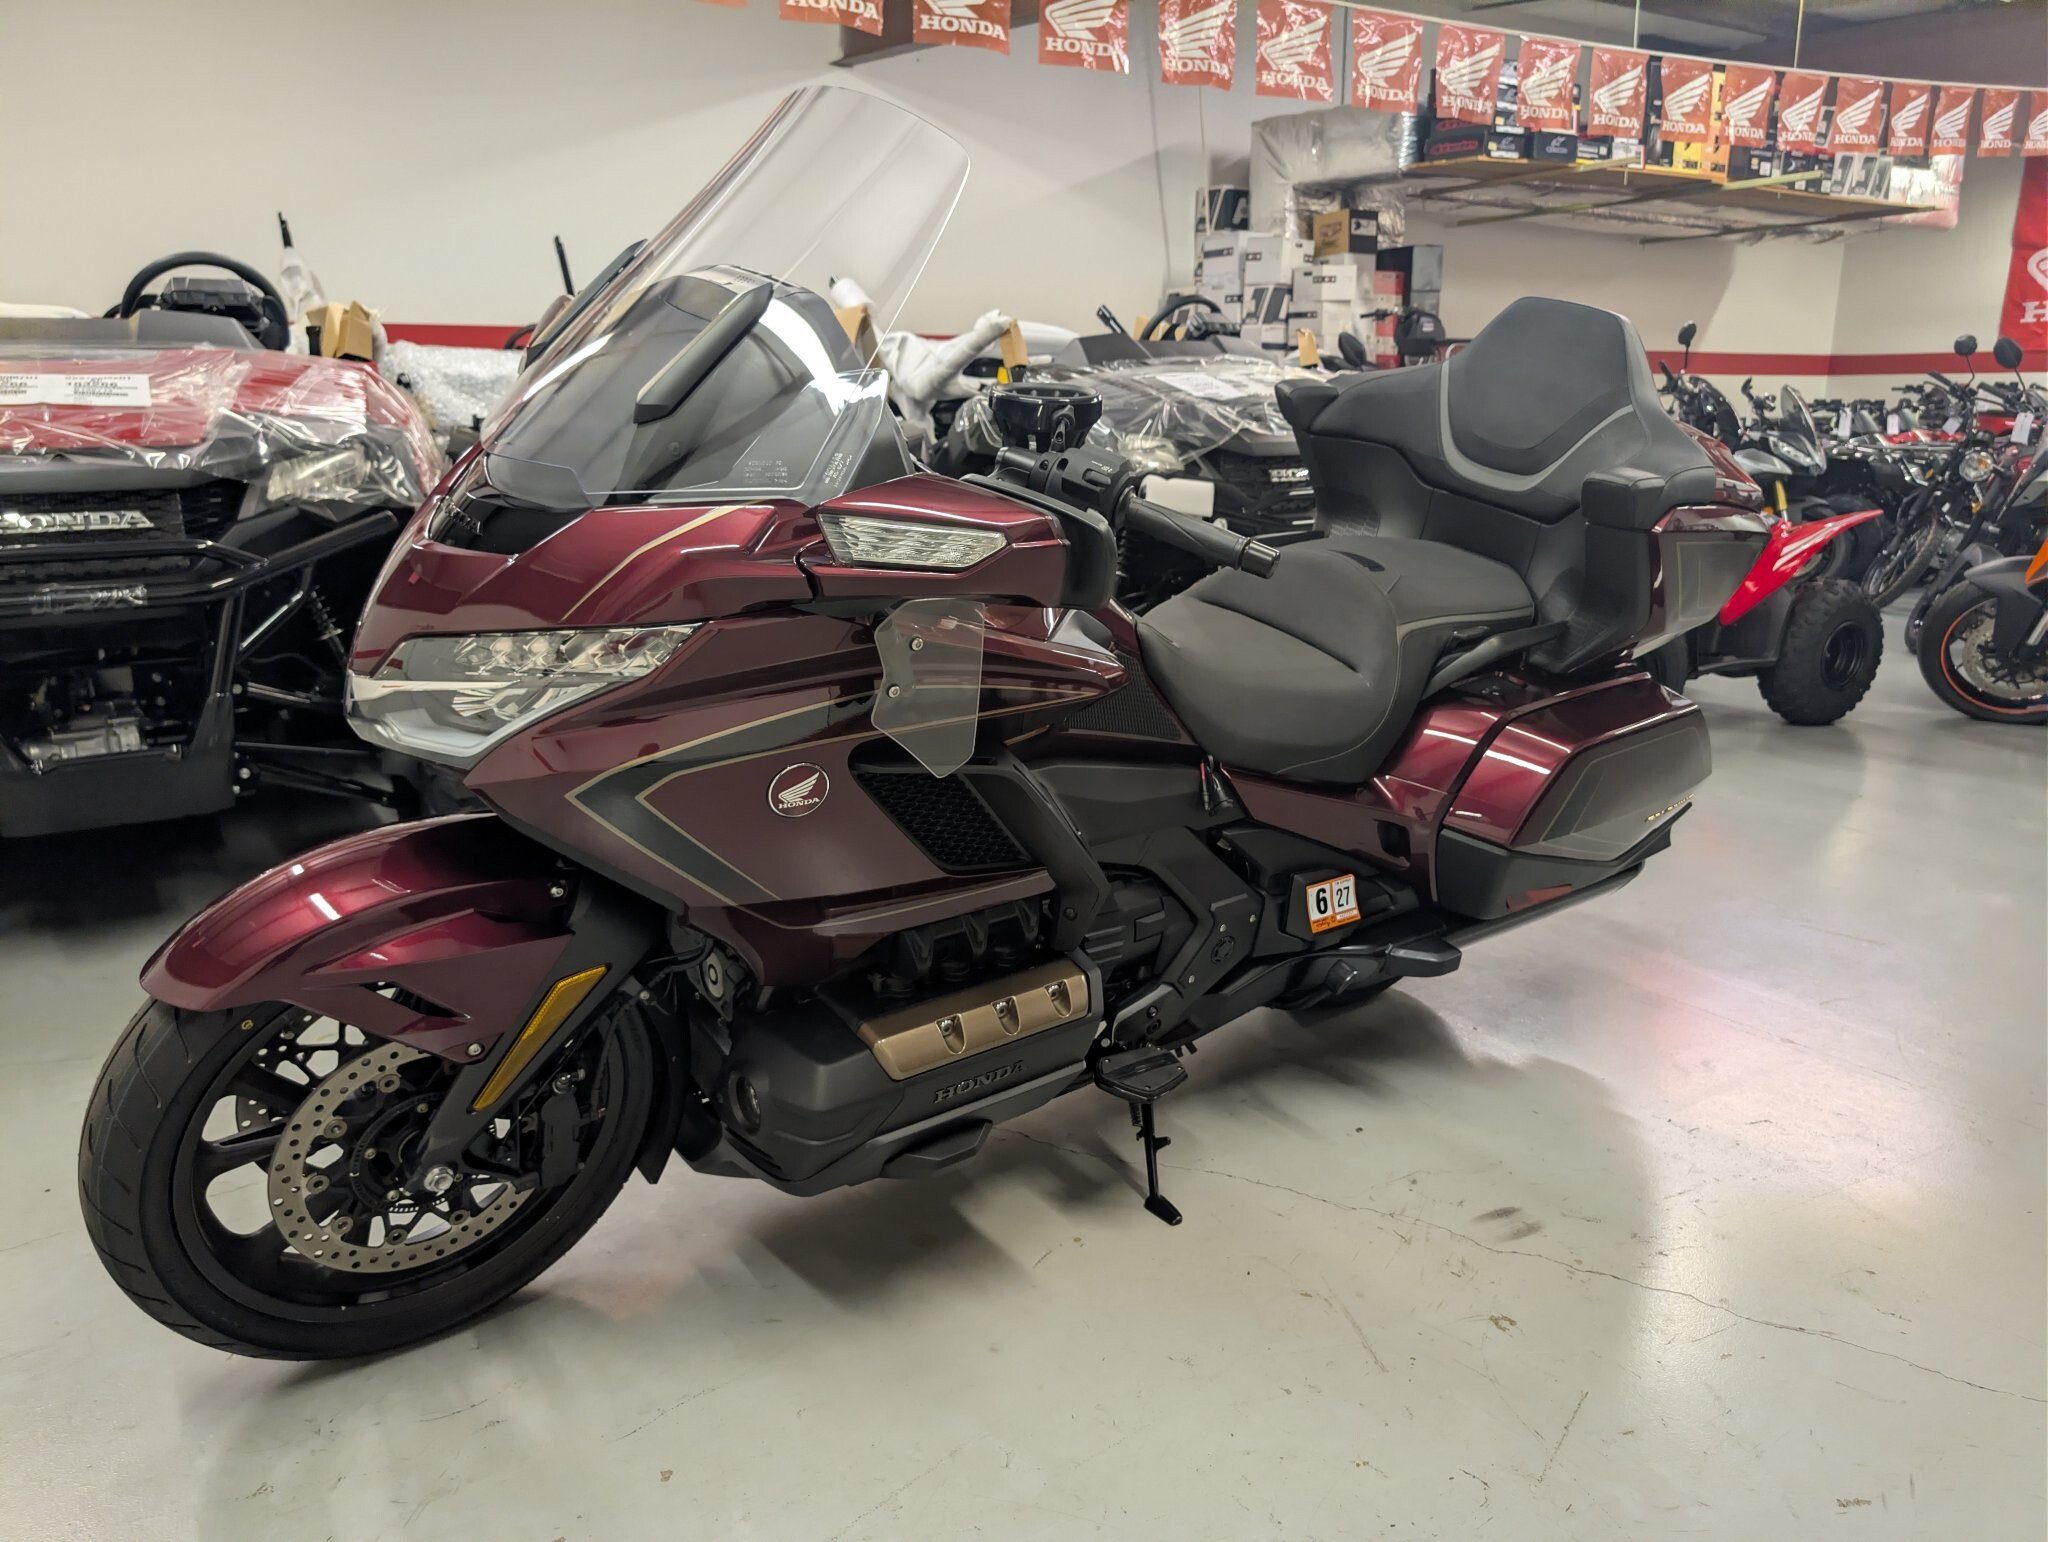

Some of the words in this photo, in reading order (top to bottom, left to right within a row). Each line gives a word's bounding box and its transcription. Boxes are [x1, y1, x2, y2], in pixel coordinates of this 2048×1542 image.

[919, 14, 1008, 42] HONDA
[1164, 57, 1230, 80] HONDA
[1357, 83, 1415, 104] HONDA
[1519, 104, 1570, 121] HONDA
[1661, 120, 1707, 135] HONDA
[1833, 133, 1877, 145] HONDA
[0, 510, 155, 534] ONDA
[777, 797, 821, 809] HONDA
[1315, 887, 1328, 915] 6
[1336, 885, 1350, 908] 27
[933, 1060, 1026, 1103] HONDA
